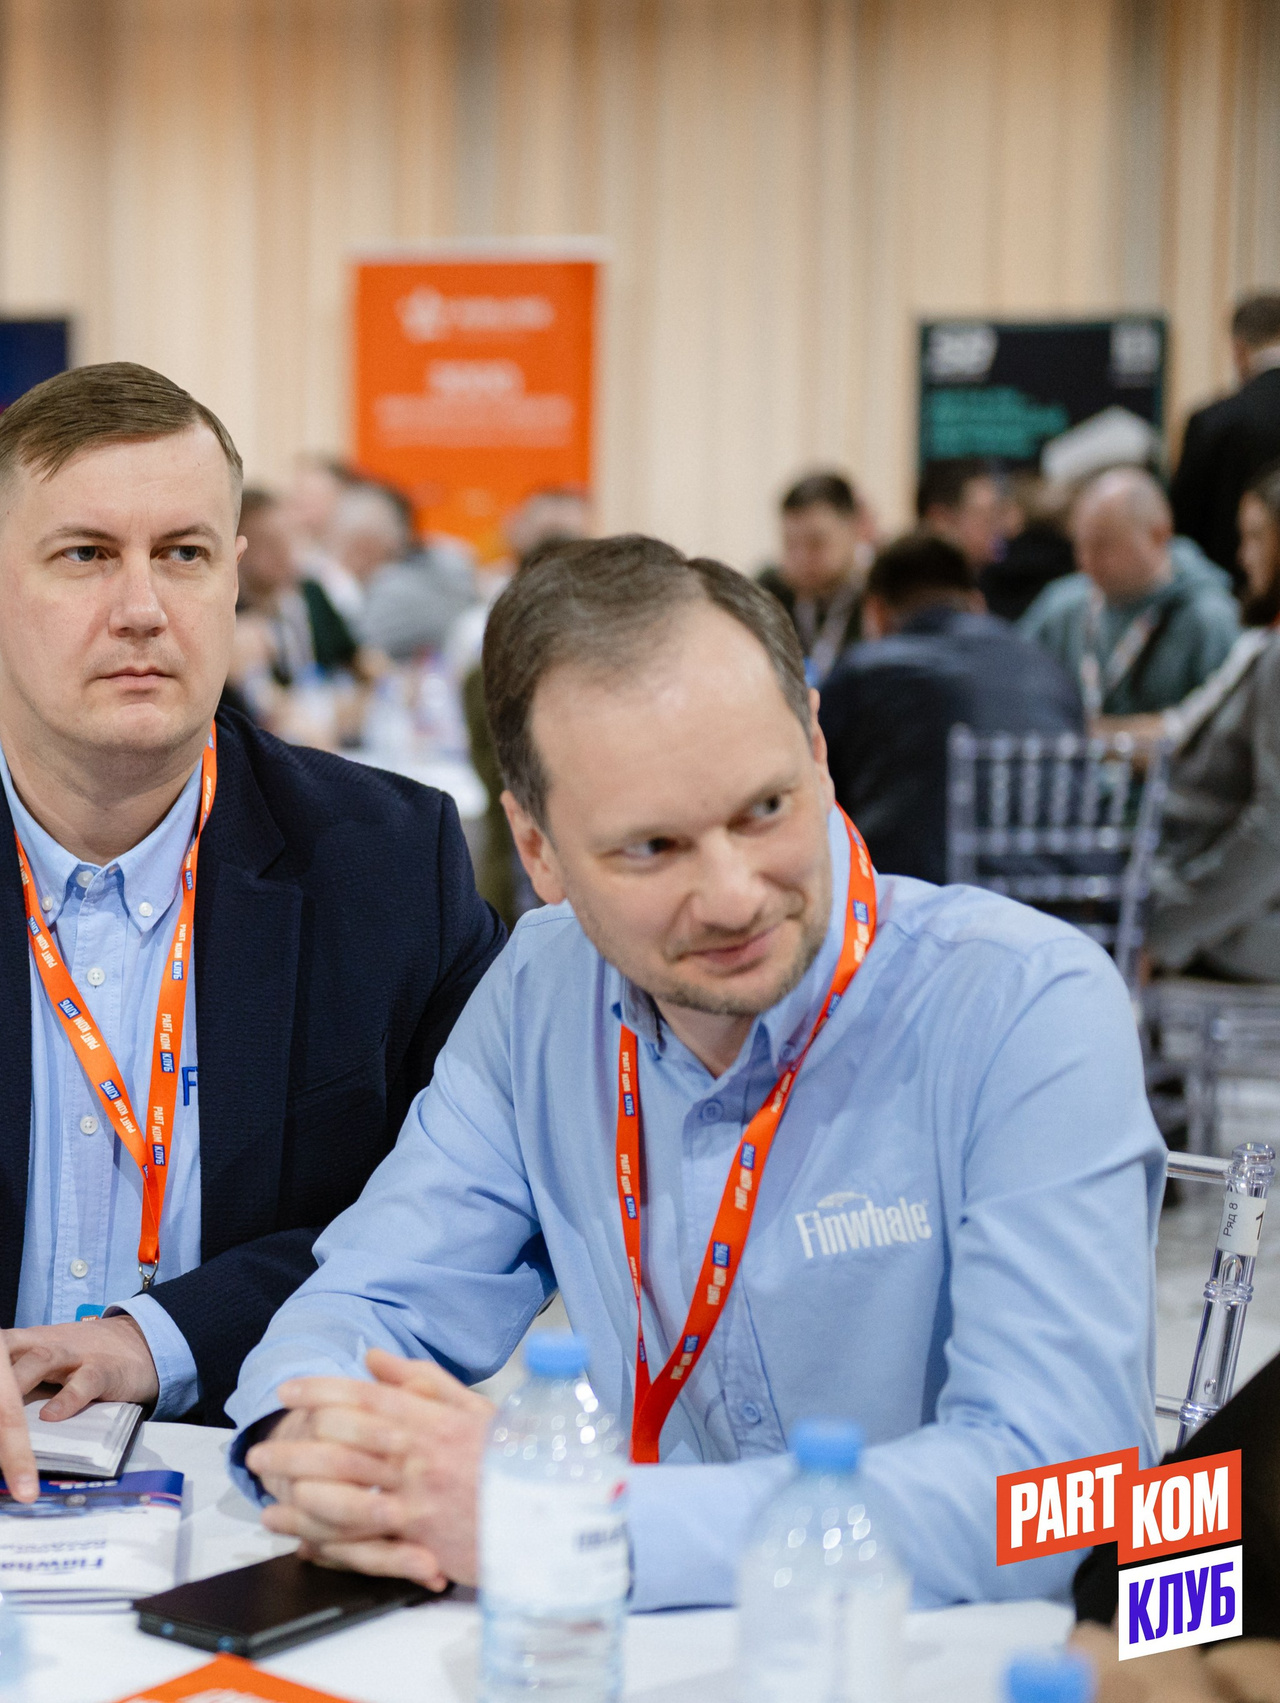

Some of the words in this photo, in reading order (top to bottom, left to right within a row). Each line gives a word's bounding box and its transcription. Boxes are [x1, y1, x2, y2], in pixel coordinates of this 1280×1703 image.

[60, 998, 80, 1018] КЛУБ
[73, 1016, 91, 1033] KOM
[162, 1013, 173, 1033] PART
[80, 1031, 100, 1050] PART
[160, 1033, 171, 1050] KOM
[162, 1052, 174, 1073] КЛУБ
[101, 1080, 120, 1100] КЛУБ
[114, 1099, 129, 1116] KOM
[153, 1106, 164, 1126] PART
[120, 1114, 136, 1134] PART
[152, 1126, 163, 1143] KOM
[155, 1145, 165, 1165] КЛУБ
[620, 1154, 631, 1175] PART
[625, 1196, 637, 1218] КЛУБ
[1228, 1202, 1238, 1210] 8
[795, 1195, 933, 1259] Finwhale
[1223, 1213, 1238, 1237] Ряд
